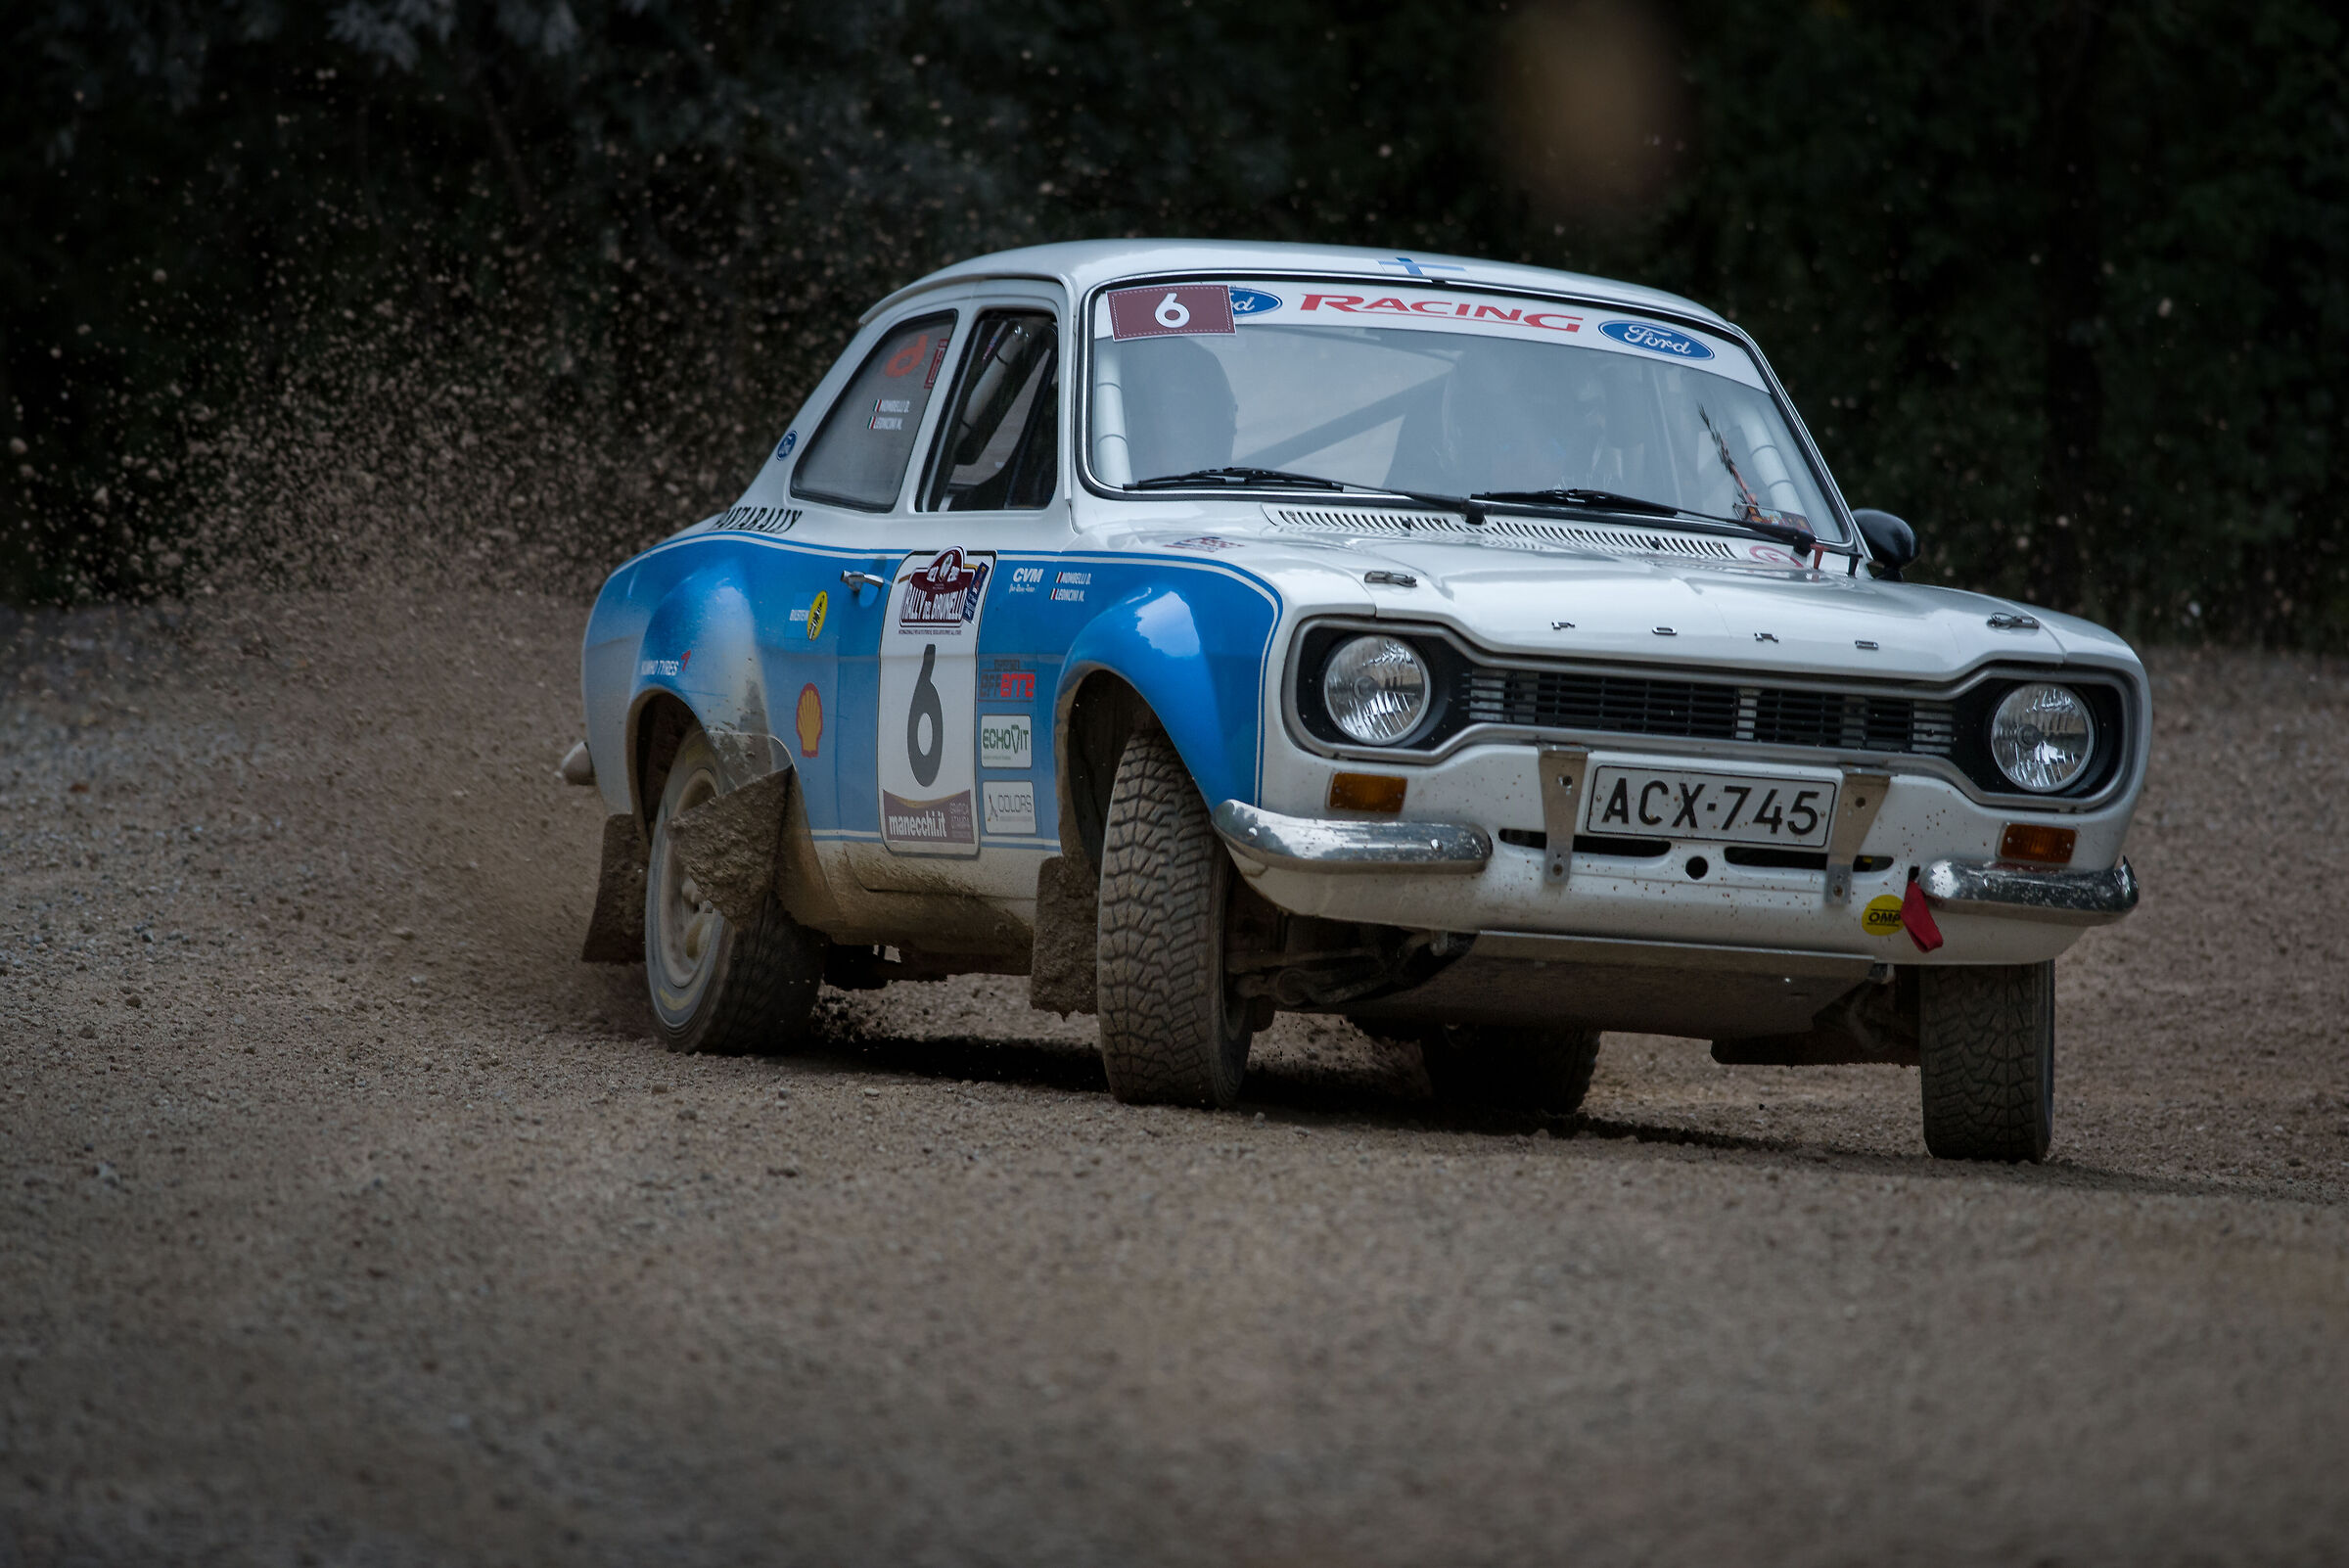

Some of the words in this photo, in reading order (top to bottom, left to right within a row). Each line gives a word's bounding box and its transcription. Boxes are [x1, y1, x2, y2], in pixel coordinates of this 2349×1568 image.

[1155, 293, 1190, 328] 6
[1301, 294, 1584, 333] RACING
[1623, 324, 1691, 354] Ford
[1013, 568, 1044, 582] CVM
[907, 644, 943, 787] 6
[889, 810, 947, 838] manecchi.it
